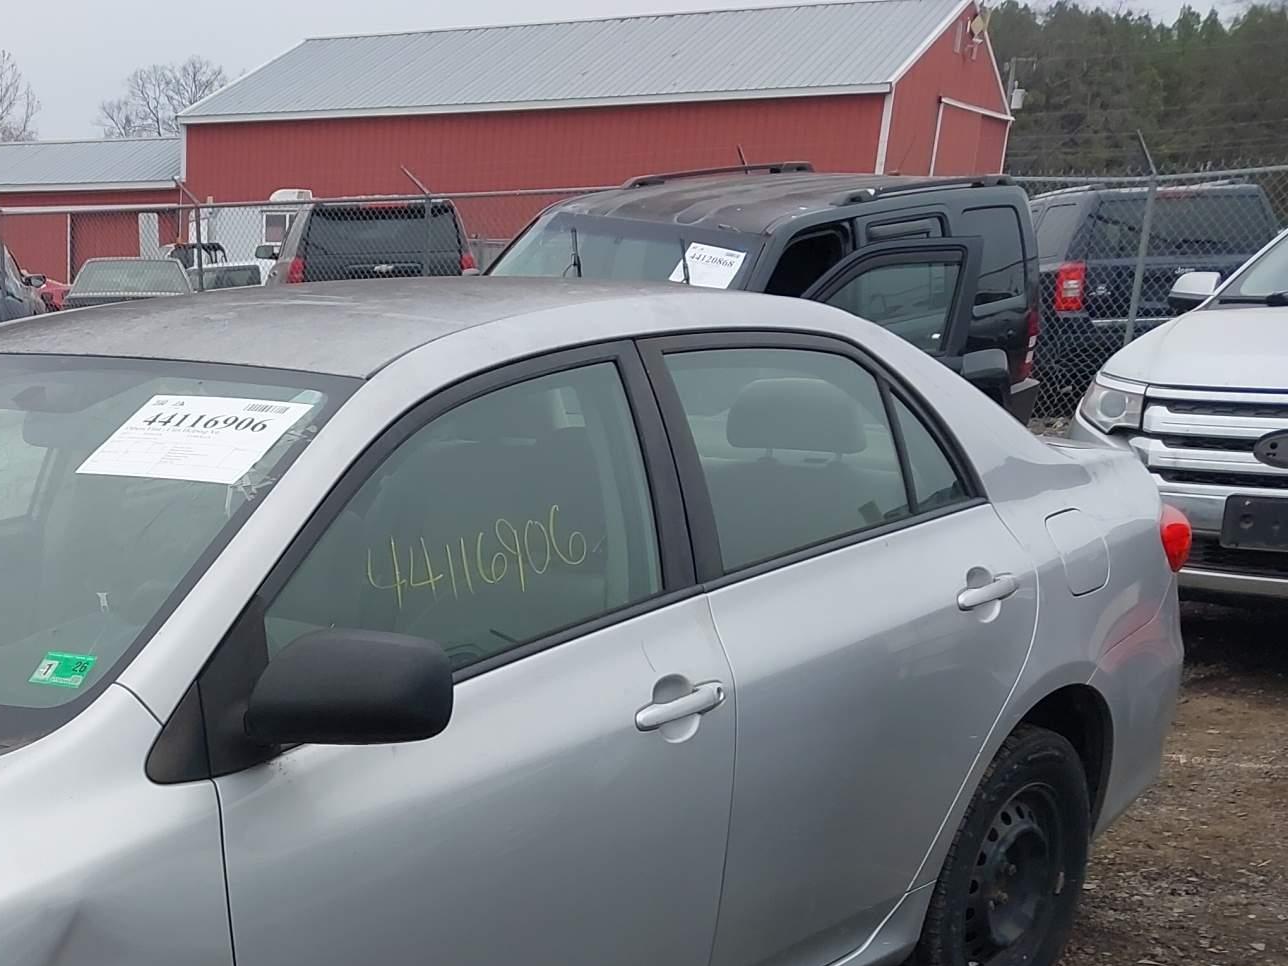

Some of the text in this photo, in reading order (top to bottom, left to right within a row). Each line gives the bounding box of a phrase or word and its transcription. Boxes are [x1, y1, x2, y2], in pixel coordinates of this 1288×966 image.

[143, 412, 274, 433] 44116906
[367, 504, 587, 609] 44116906
[72, 661, 90, 673] 26
